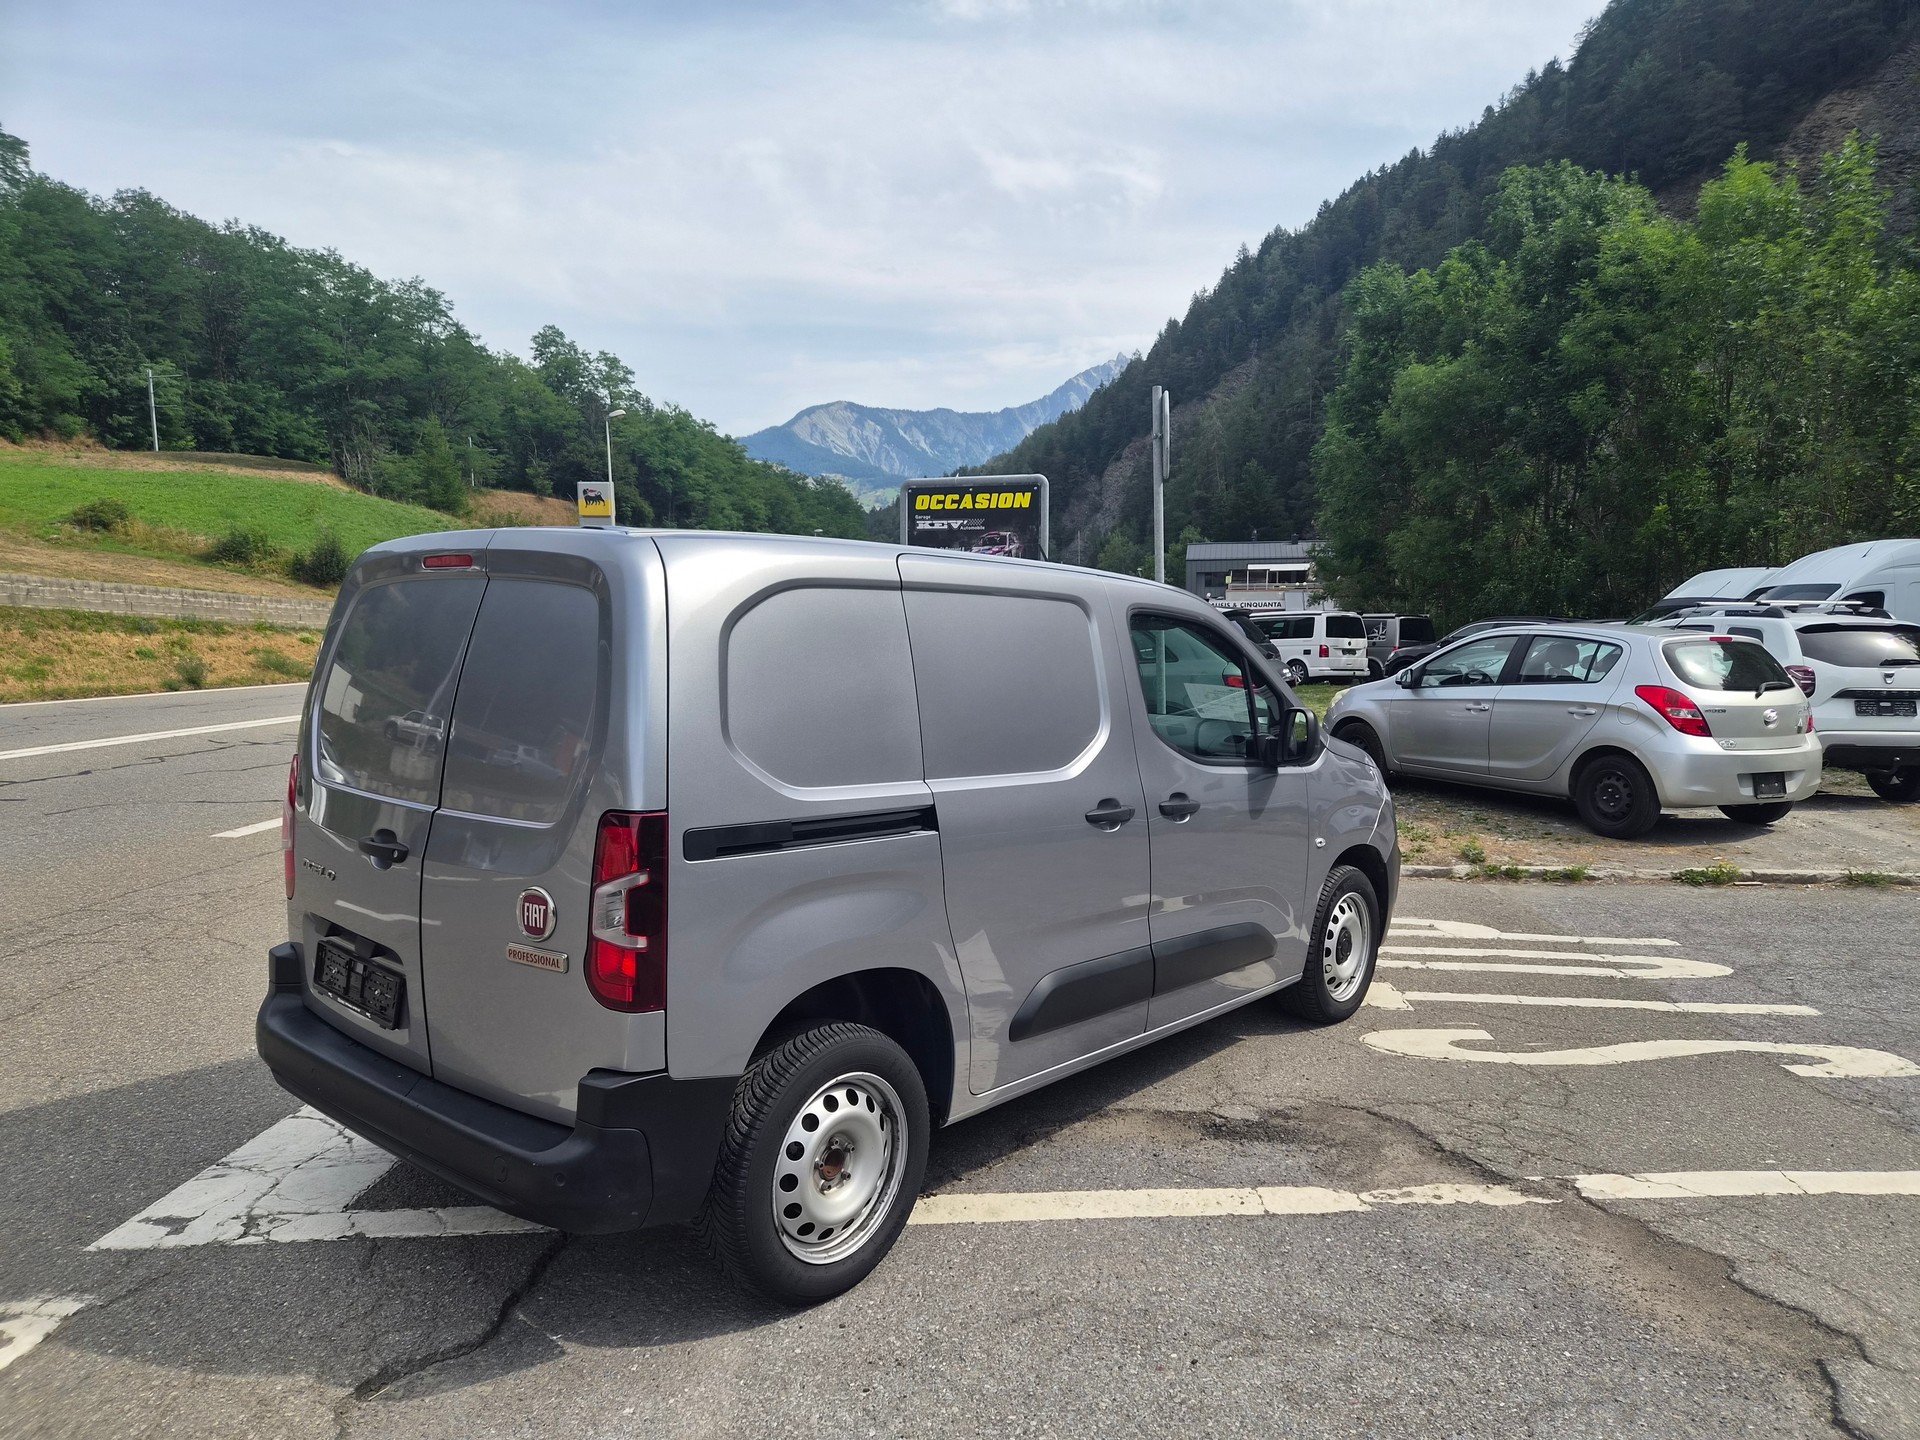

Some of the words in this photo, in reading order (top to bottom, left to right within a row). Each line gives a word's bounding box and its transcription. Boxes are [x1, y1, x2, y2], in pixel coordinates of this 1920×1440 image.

[915, 492, 1032, 510] OCCASION
[523, 902, 547, 929] FIAT
[508, 948, 561, 969] PROFESSIONAL
